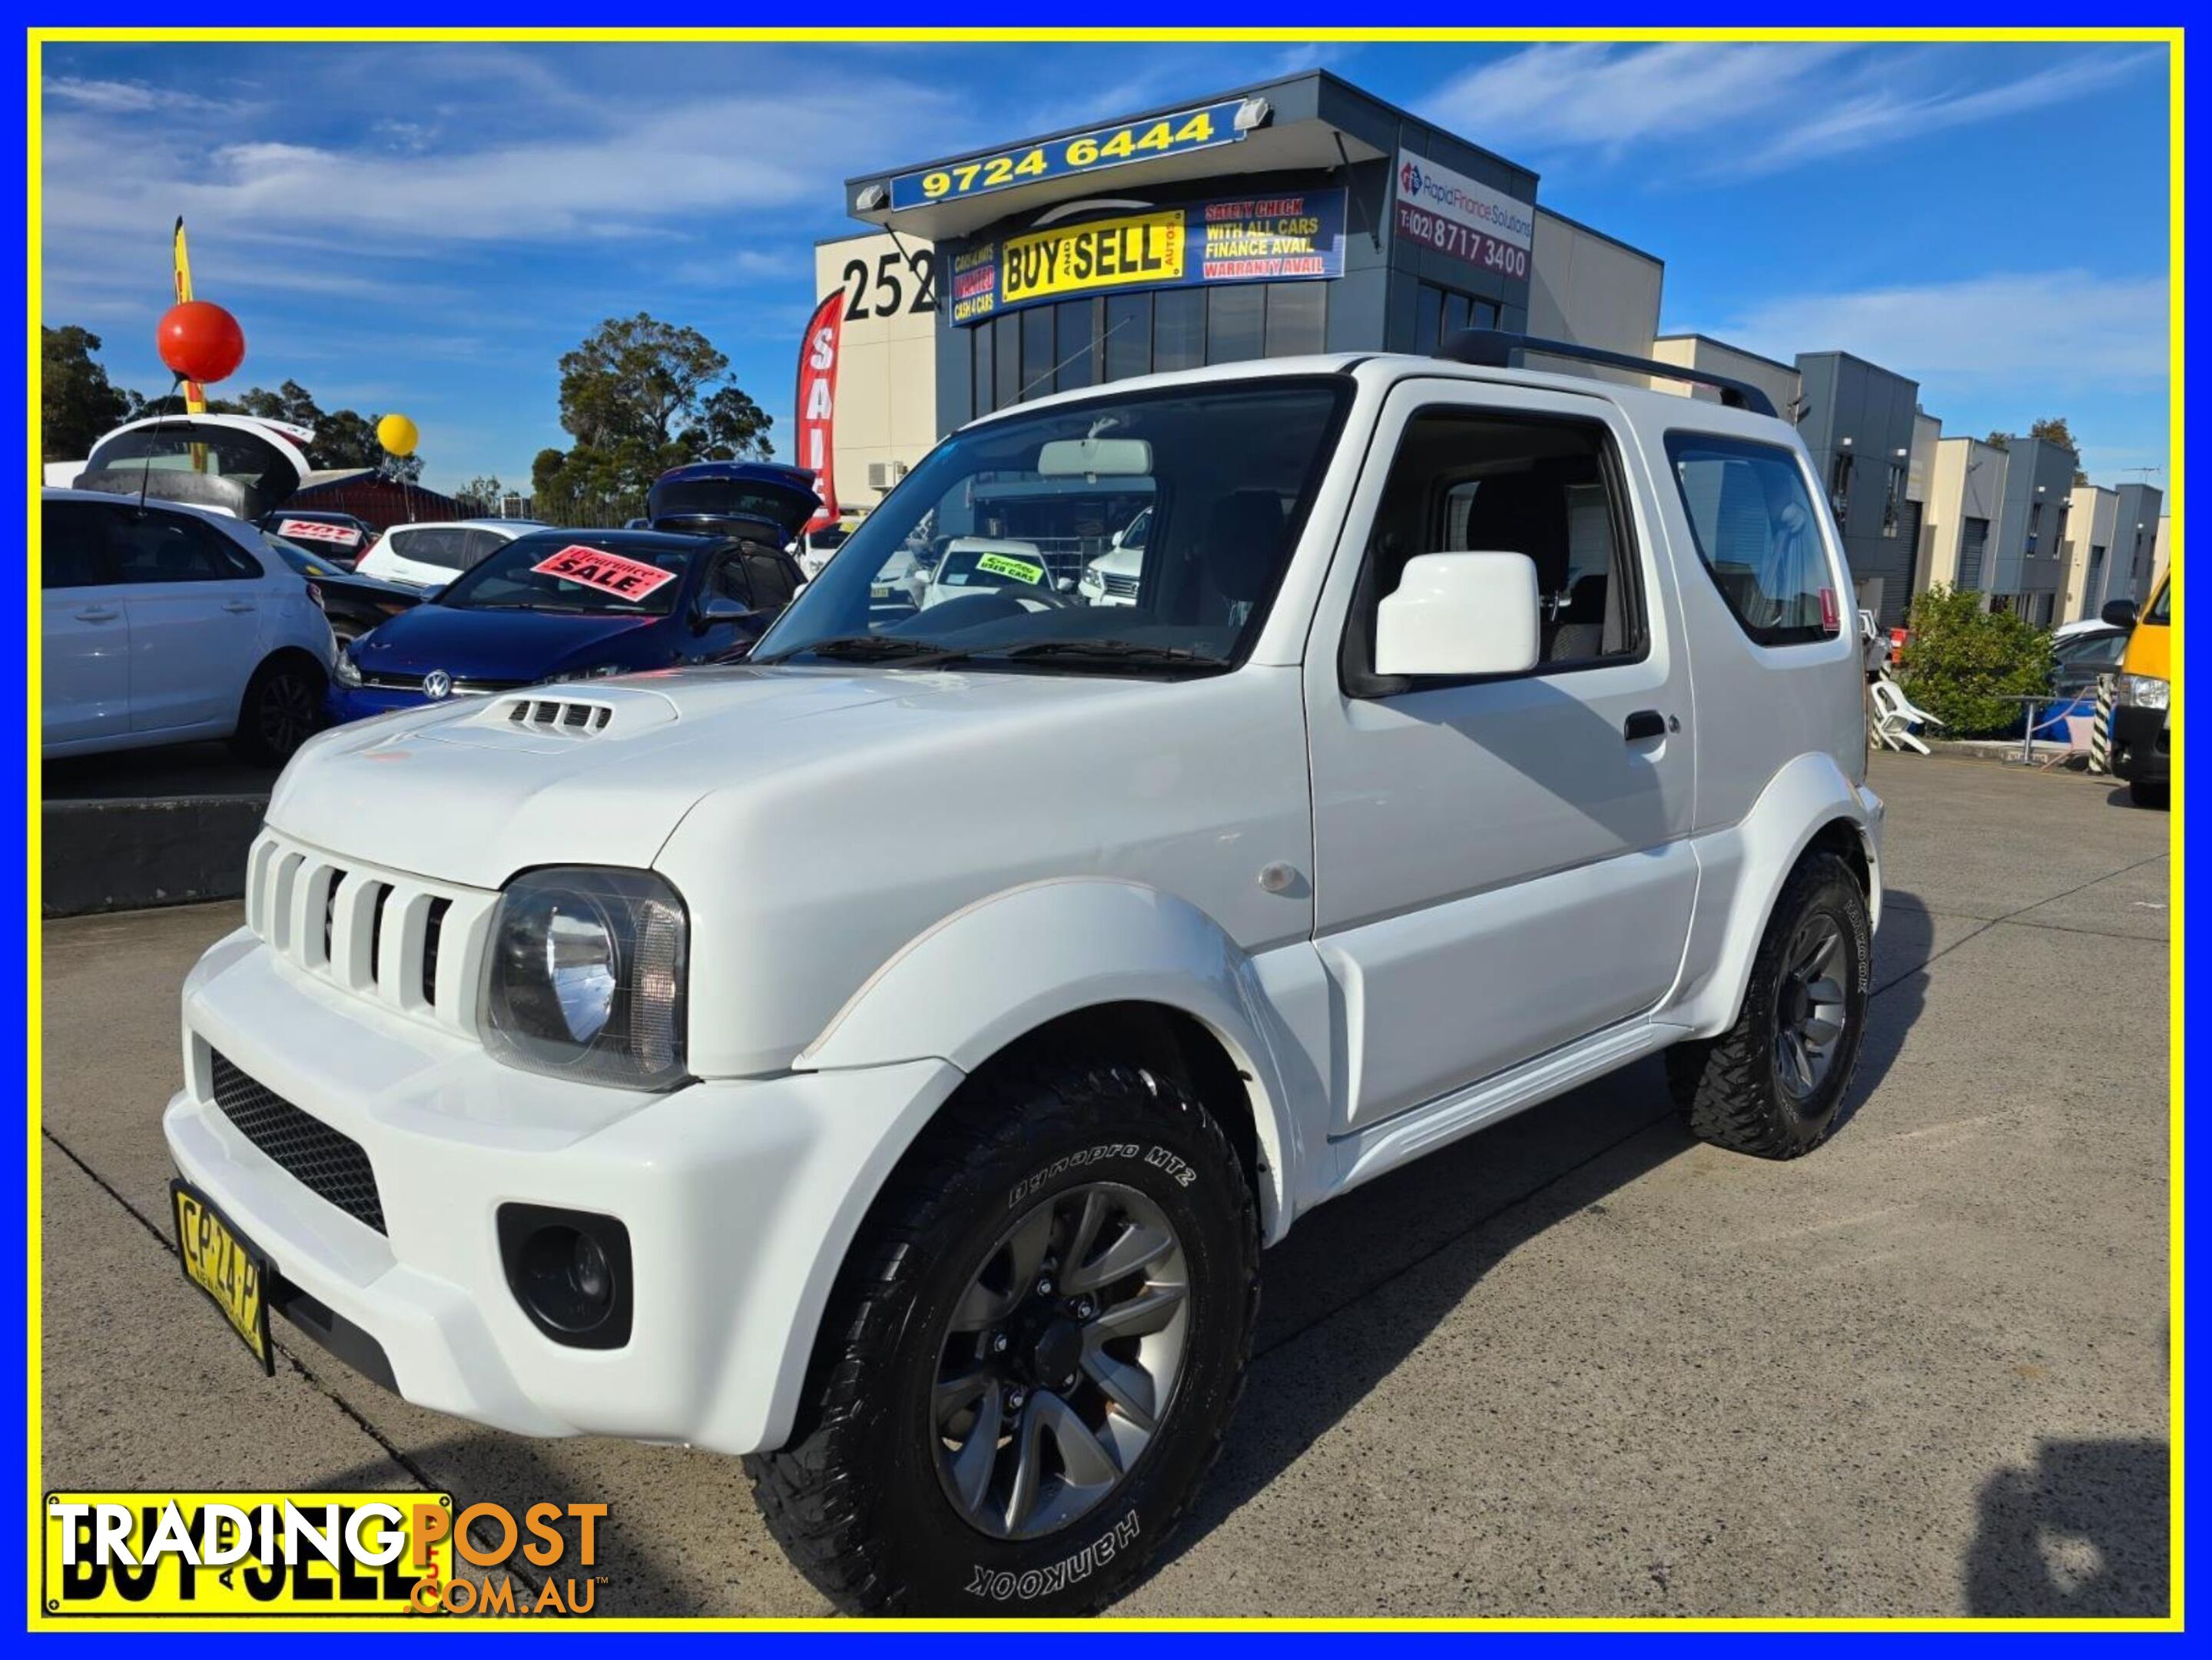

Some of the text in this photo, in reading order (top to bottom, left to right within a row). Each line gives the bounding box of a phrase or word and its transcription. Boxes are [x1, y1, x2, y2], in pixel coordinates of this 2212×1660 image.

[923, 113, 1214, 198] 9724 6444
[1255, 198, 1304, 217] CHECK
[1165, 221, 1176, 266] AUTOS
[1205, 237, 1315, 259] FINANCE AVAIL
[1207, 217, 1318, 241] WITH ALL CARS
[1007, 237, 1062, 292] BUY
[1063, 241, 1072, 276] AND
[1073, 224, 1162, 280] SELL
[1203, 256, 1325, 279] WARRANTY AVAIL
[1485, 240, 1525, 277] 3400
[844, 250, 935, 321] 252
[551, 558, 642, 593] SALE
[1009, 1144, 1196, 1209] Dynapro MT2
[964, 1509, 1140, 1600] Hankook
